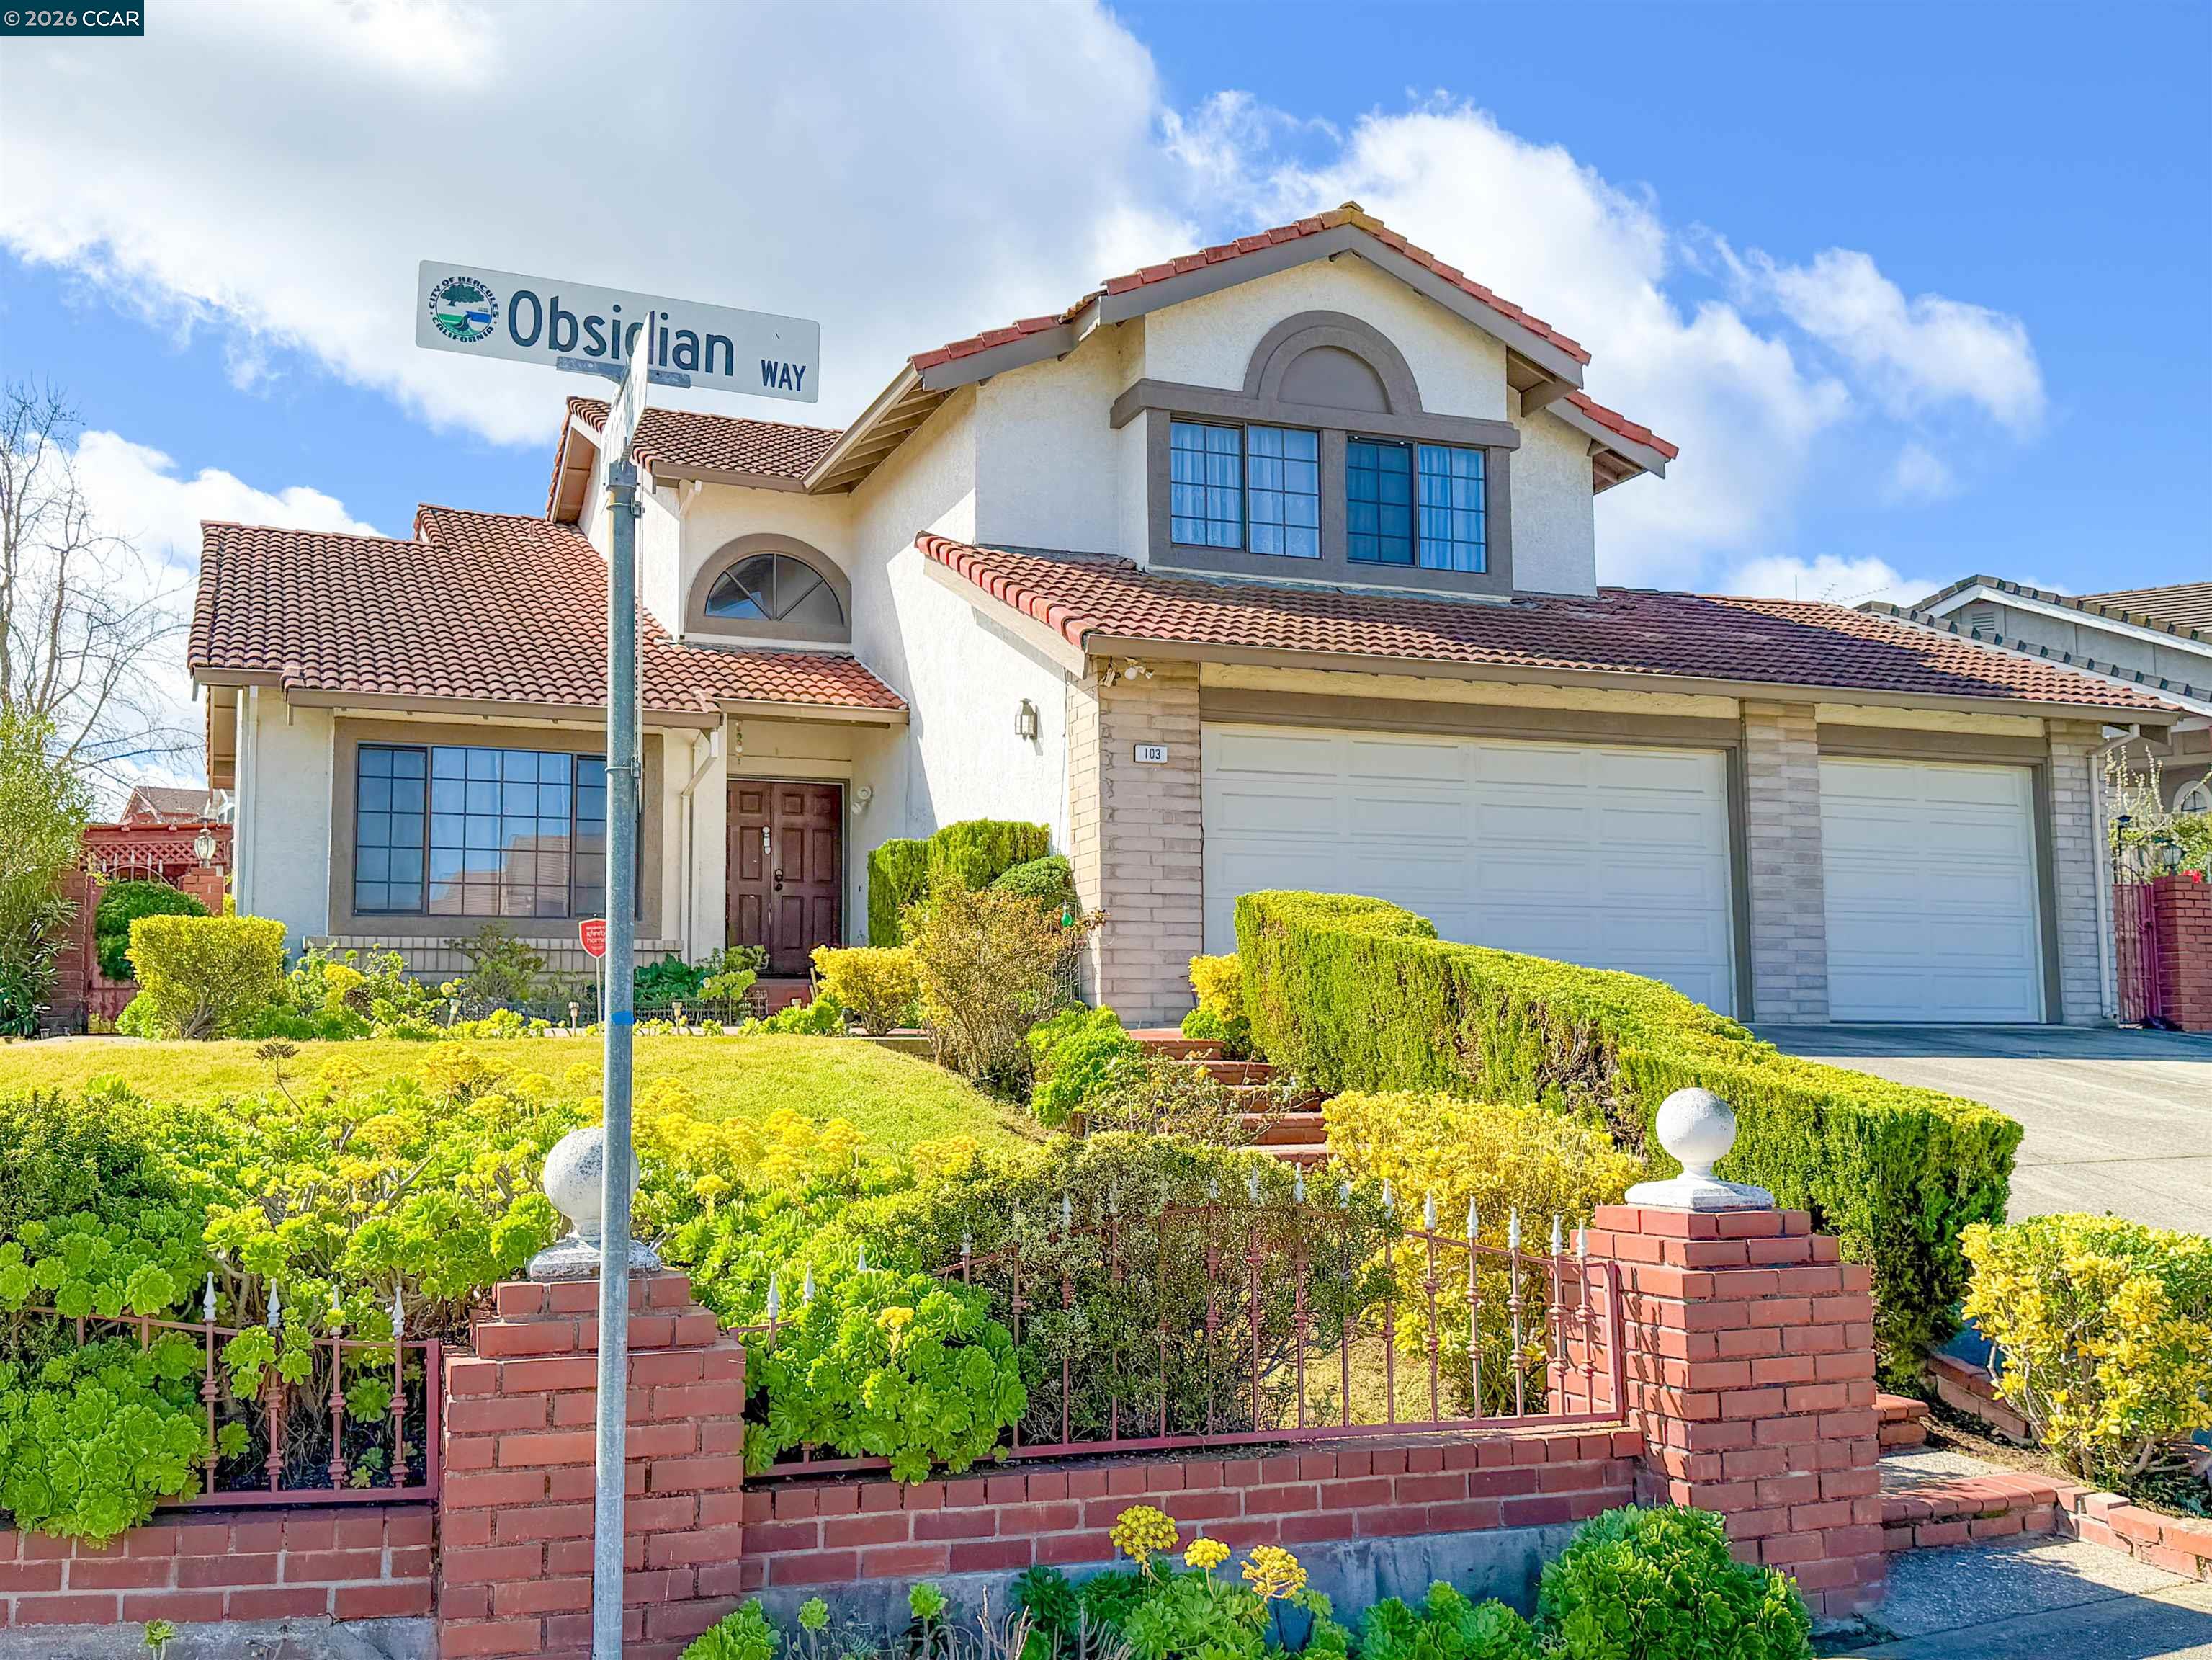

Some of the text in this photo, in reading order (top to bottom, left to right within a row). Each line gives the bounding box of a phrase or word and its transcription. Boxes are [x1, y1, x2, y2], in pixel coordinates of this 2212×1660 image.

[429, 276, 499, 318] CITY OF HERCULES
[432, 316, 494, 343] CALIFORNIA
[761, 359, 807, 392] WAY
[1145, 748, 1160, 759] 103
